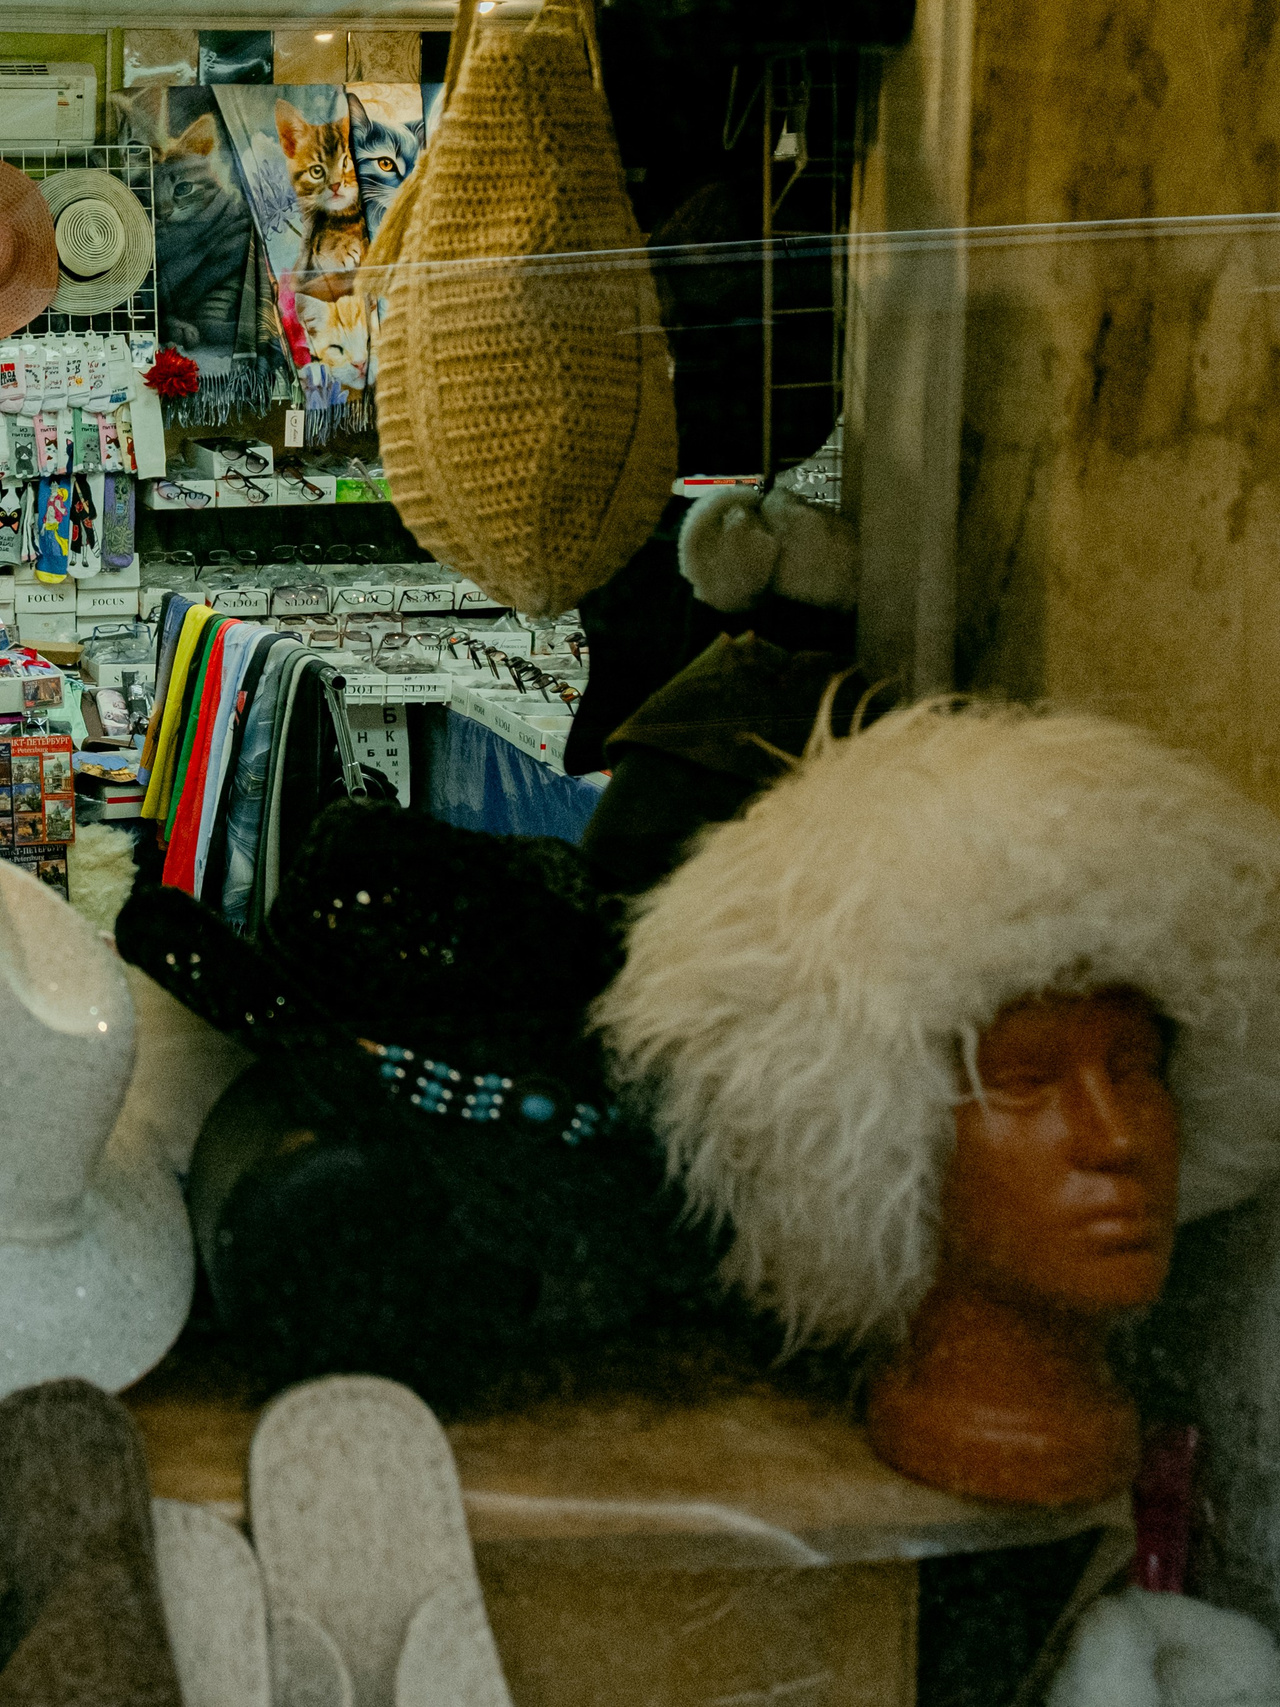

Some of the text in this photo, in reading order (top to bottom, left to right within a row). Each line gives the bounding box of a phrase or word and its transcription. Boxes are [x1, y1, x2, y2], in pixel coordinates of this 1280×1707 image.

[27, 593, 65, 603] FOCUS
[92, 598, 125, 606] FOCUS
[223, 600, 258, 608] FOCUS
[285, 599, 319, 607] FOCUS
[344, 685, 373, 694] FOC
[404, 684, 437, 693] FOCUS
[383, 707, 397, 724] Б
[357, 730, 395, 743] Н К
[11, 737, 70, 747] КТ-ПЕТЕРБУРГ
[367, 748, 398, 757] Б Ш
